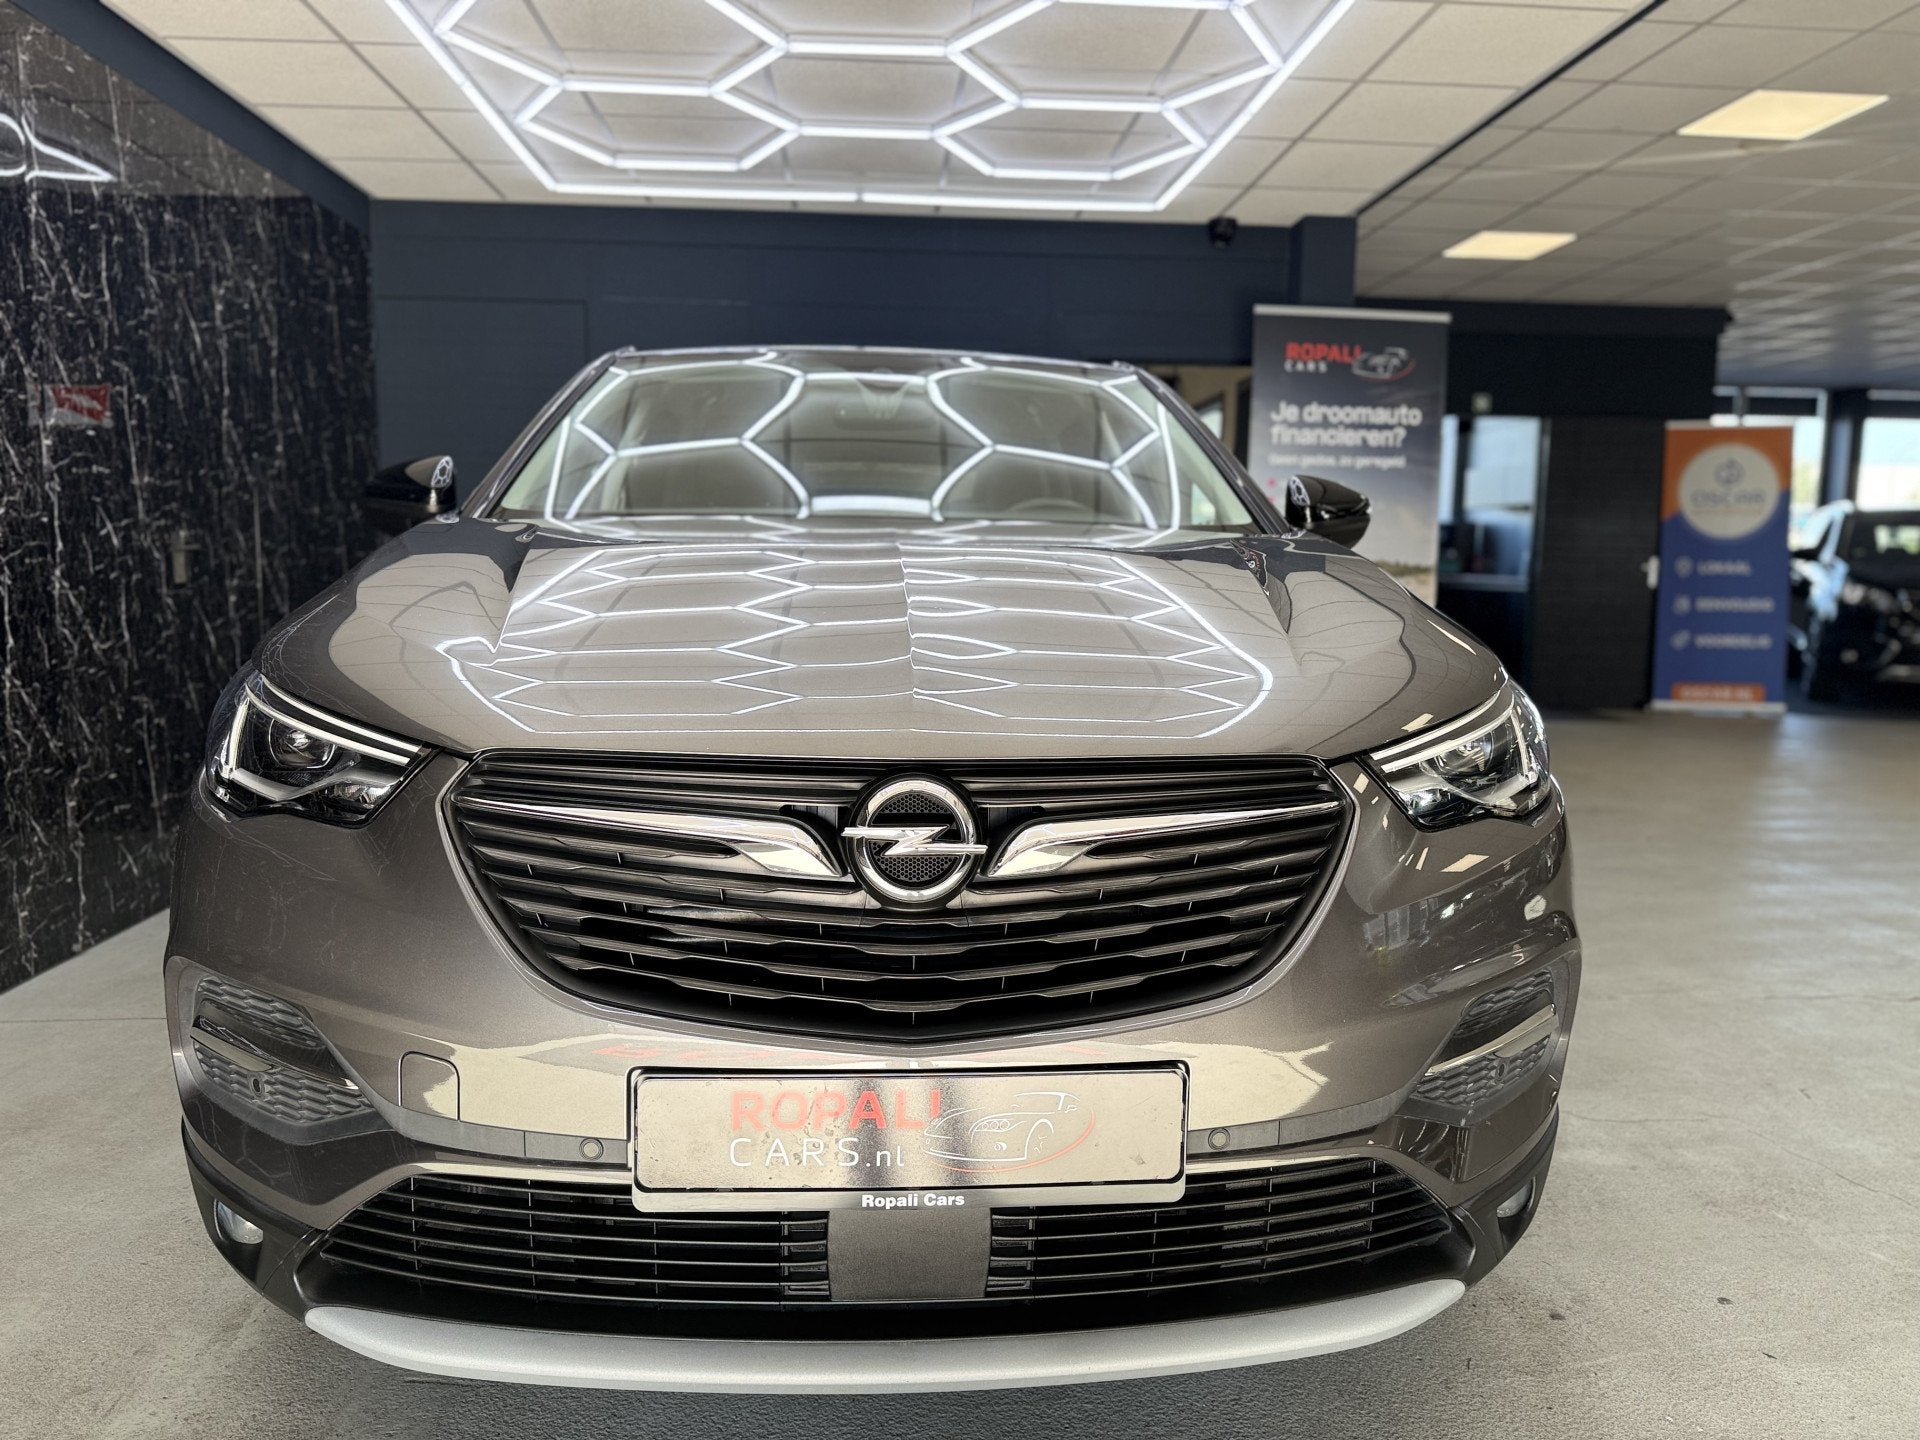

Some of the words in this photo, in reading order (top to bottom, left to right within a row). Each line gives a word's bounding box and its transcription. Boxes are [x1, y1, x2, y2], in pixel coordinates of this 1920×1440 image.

[1284, 360, 1328, 373] CARS
[1270, 401, 1298, 422] Je
[1302, 402, 1423, 426] droomauto
[1270, 424, 1408, 448] financieren?
[729, 1137, 905, 1167] CARS.nl
[861, 1194, 919, 1210] Ropali
[923, 1193, 966, 1207] Cars
